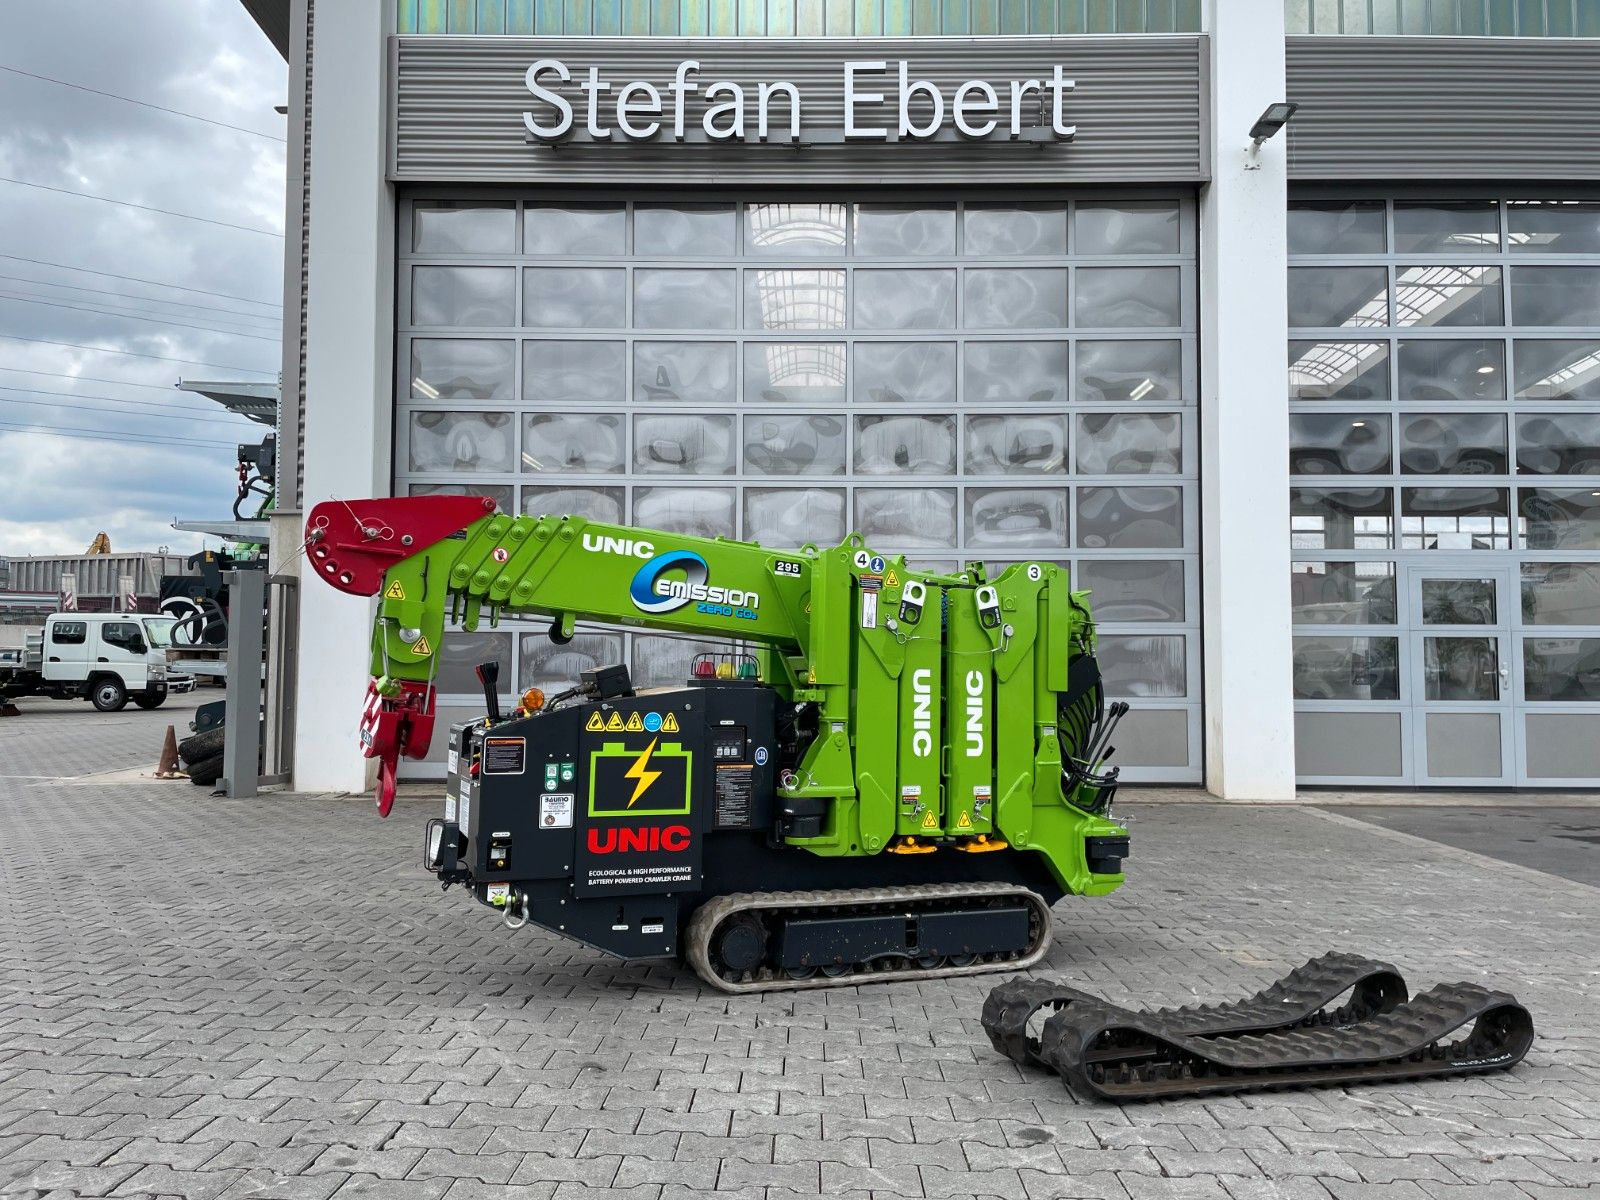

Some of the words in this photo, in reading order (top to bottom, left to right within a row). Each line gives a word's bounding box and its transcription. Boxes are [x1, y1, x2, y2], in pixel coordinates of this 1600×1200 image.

[523, 59, 801, 139] Stefan
[844, 60, 1076, 139] Ebert
[582, 533, 655, 559] UNIC
[777, 561, 799, 573] 295
[857, 553, 867, 566] 4
[1030, 566, 1039, 579] 3
[696, 602, 733, 617] ZERO
[912, 668, 932, 758] UNIC
[965, 670, 984, 757] UNIC
[586, 825, 691, 855] UNIC
[588, 869, 626, 877] ECOLOGICAL
[649, 866, 692, 874] PERFORMANCE
